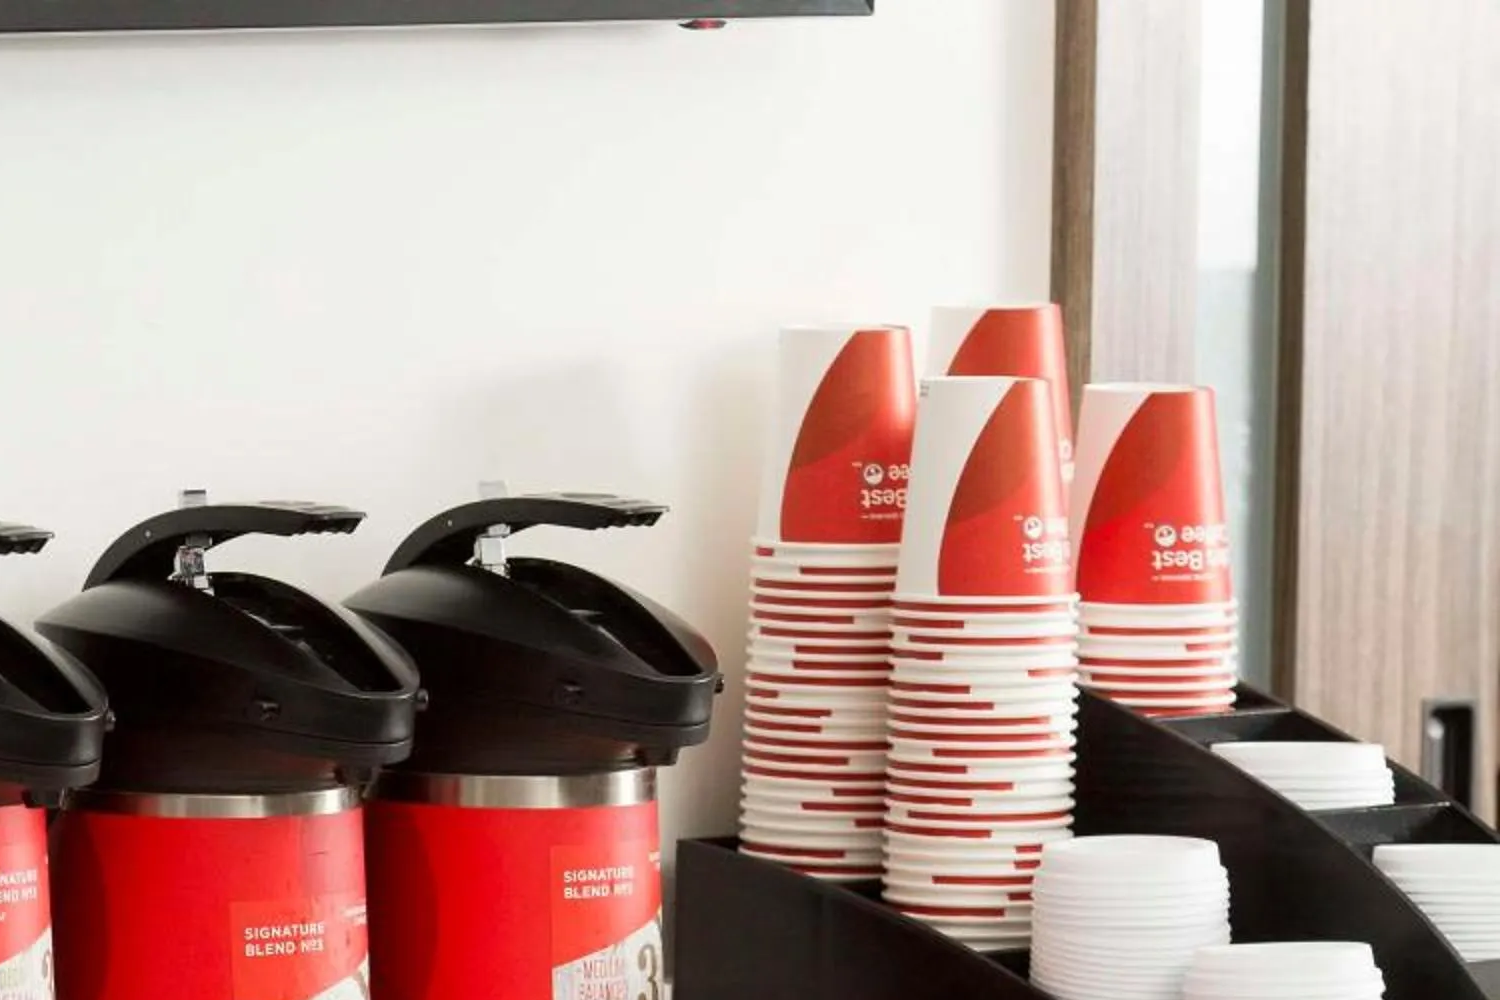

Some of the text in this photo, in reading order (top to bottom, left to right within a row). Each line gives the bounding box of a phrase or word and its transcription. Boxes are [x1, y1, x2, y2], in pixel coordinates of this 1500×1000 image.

[860, 487, 907, 509] Best
[1151, 550, 1203, 570] Best
[563, 884, 611, 899] BLEND
[244, 922, 325, 940] SIGNATURE
[244, 940, 296, 957] BLEND
